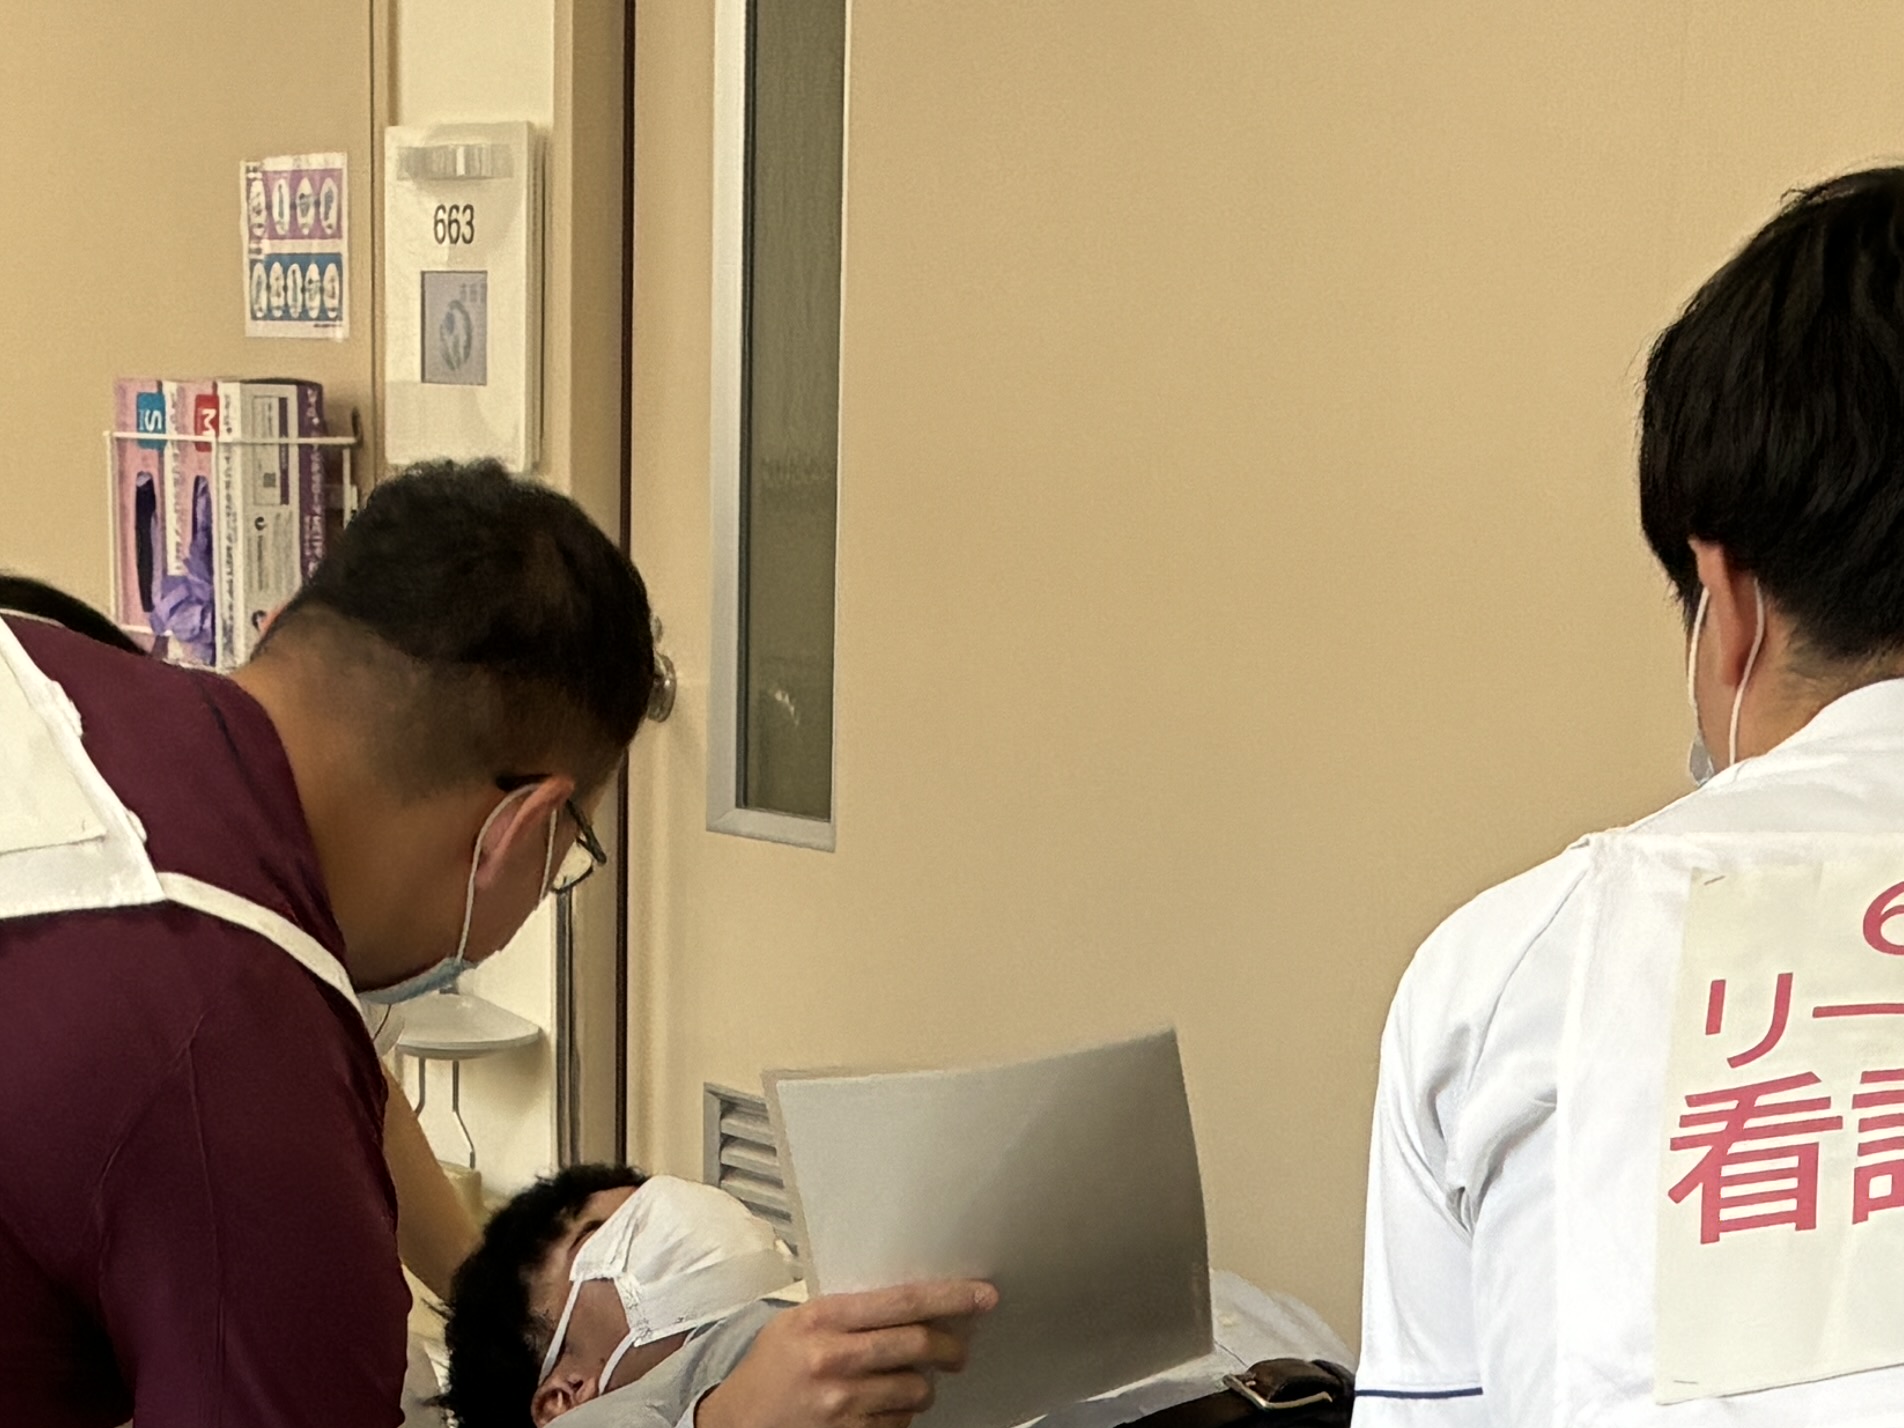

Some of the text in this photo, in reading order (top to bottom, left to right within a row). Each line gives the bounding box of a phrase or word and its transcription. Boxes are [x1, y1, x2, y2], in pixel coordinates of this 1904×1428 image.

[433, 204, 475, 245] 663
[145, 410, 162, 431] S
[202, 408, 216, 435] M
